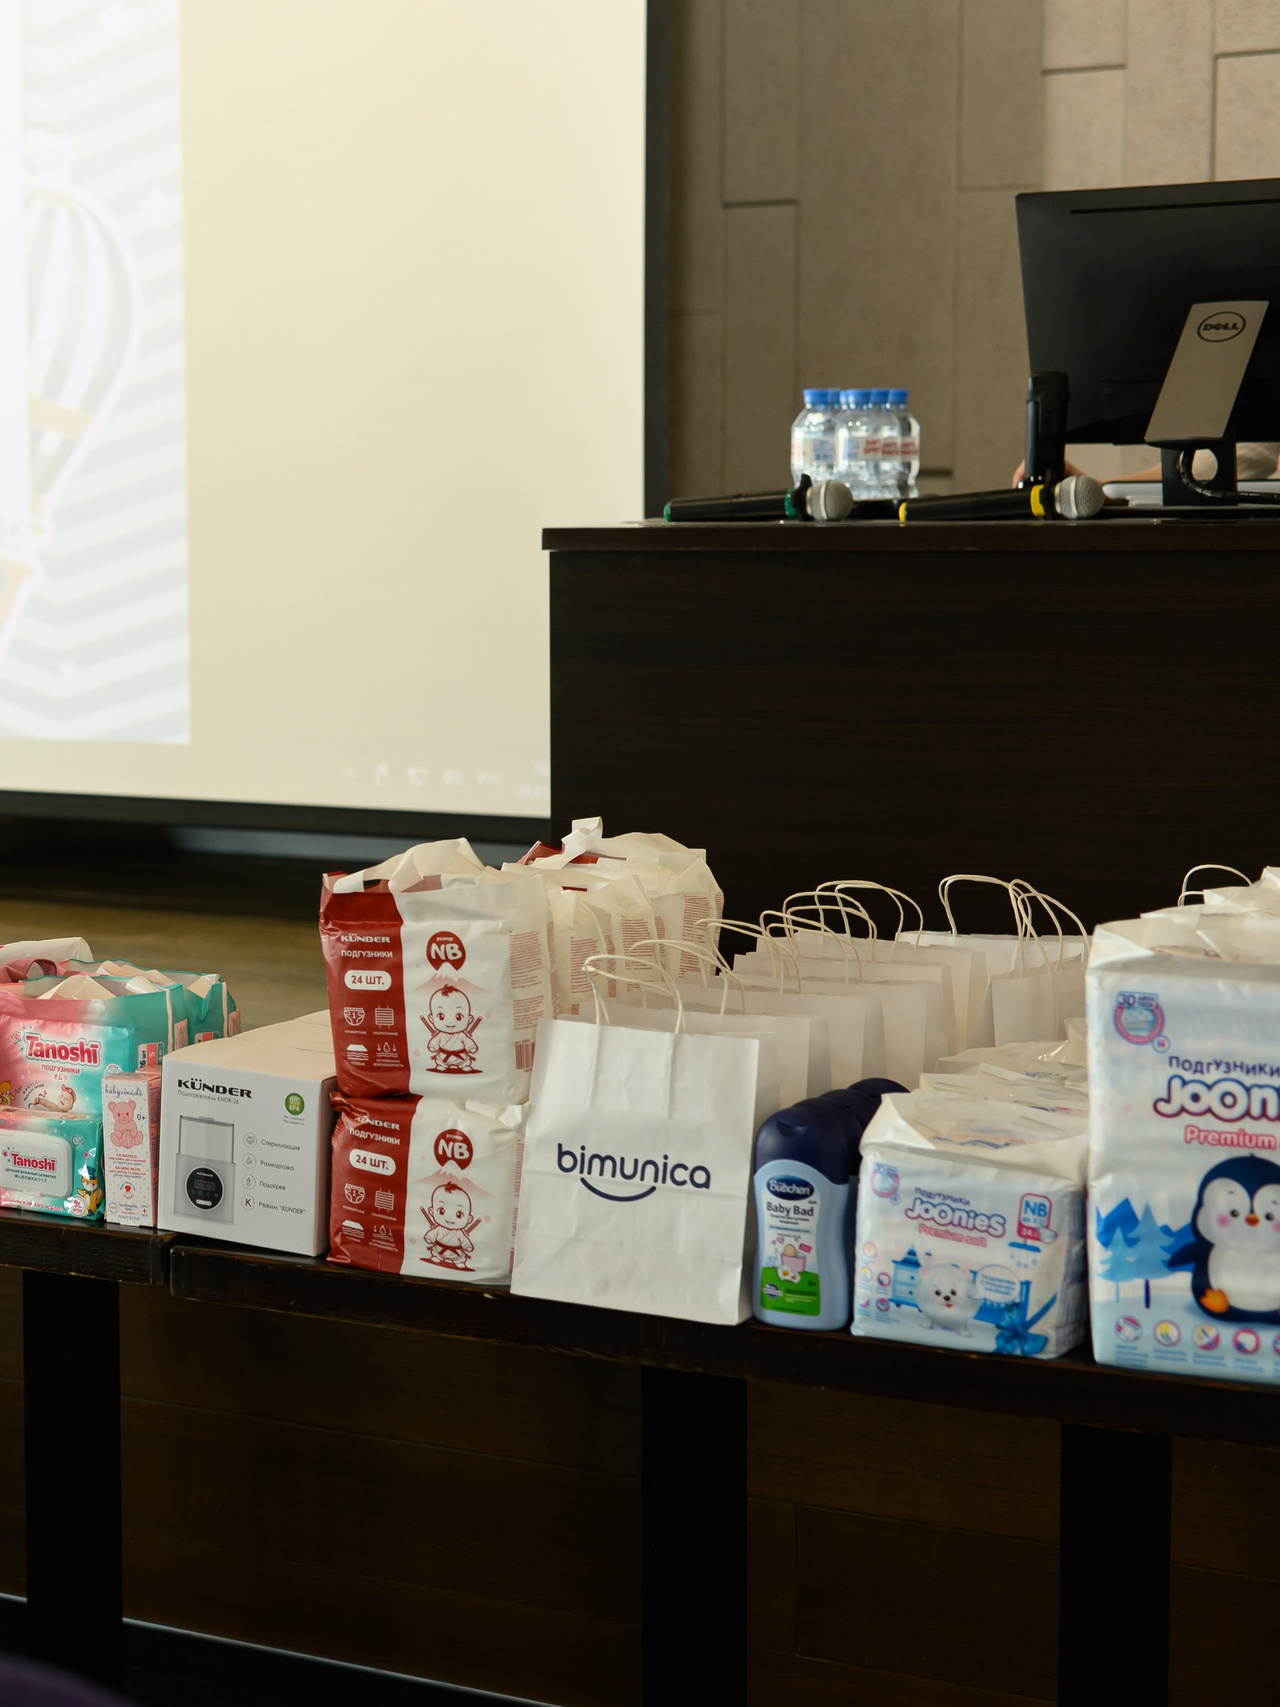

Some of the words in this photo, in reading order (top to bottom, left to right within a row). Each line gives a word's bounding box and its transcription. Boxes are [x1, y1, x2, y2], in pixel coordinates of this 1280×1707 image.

[1202, 322, 1240, 331] DELL
[341, 949, 393, 958] ПОДГУЗНИКИ
[430, 942, 463, 960] NB
[351, 975, 363, 985] 24
[365, 975, 385, 985] ШТ.
[177, 1077, 253, 1099] KÜNDER
[349, 1127, 400, 1145] ПОДГУЗНИКИ
[1184, 1125, 1278, 1151] Premium
[438, 1139, 470, 1160] NB
[260, 1159, 295, 1171] Разморозка
[355, 1154, 367, 1165] 24
[370, 1158, 389, 1170] ШТ.
[557, 1143, 711, 1189] bimunica
[766, 1202, 791, 1217] Baby
[793, 1205, 814, 1216] Bad
[1023, 1200, 1048, 1217] NB
